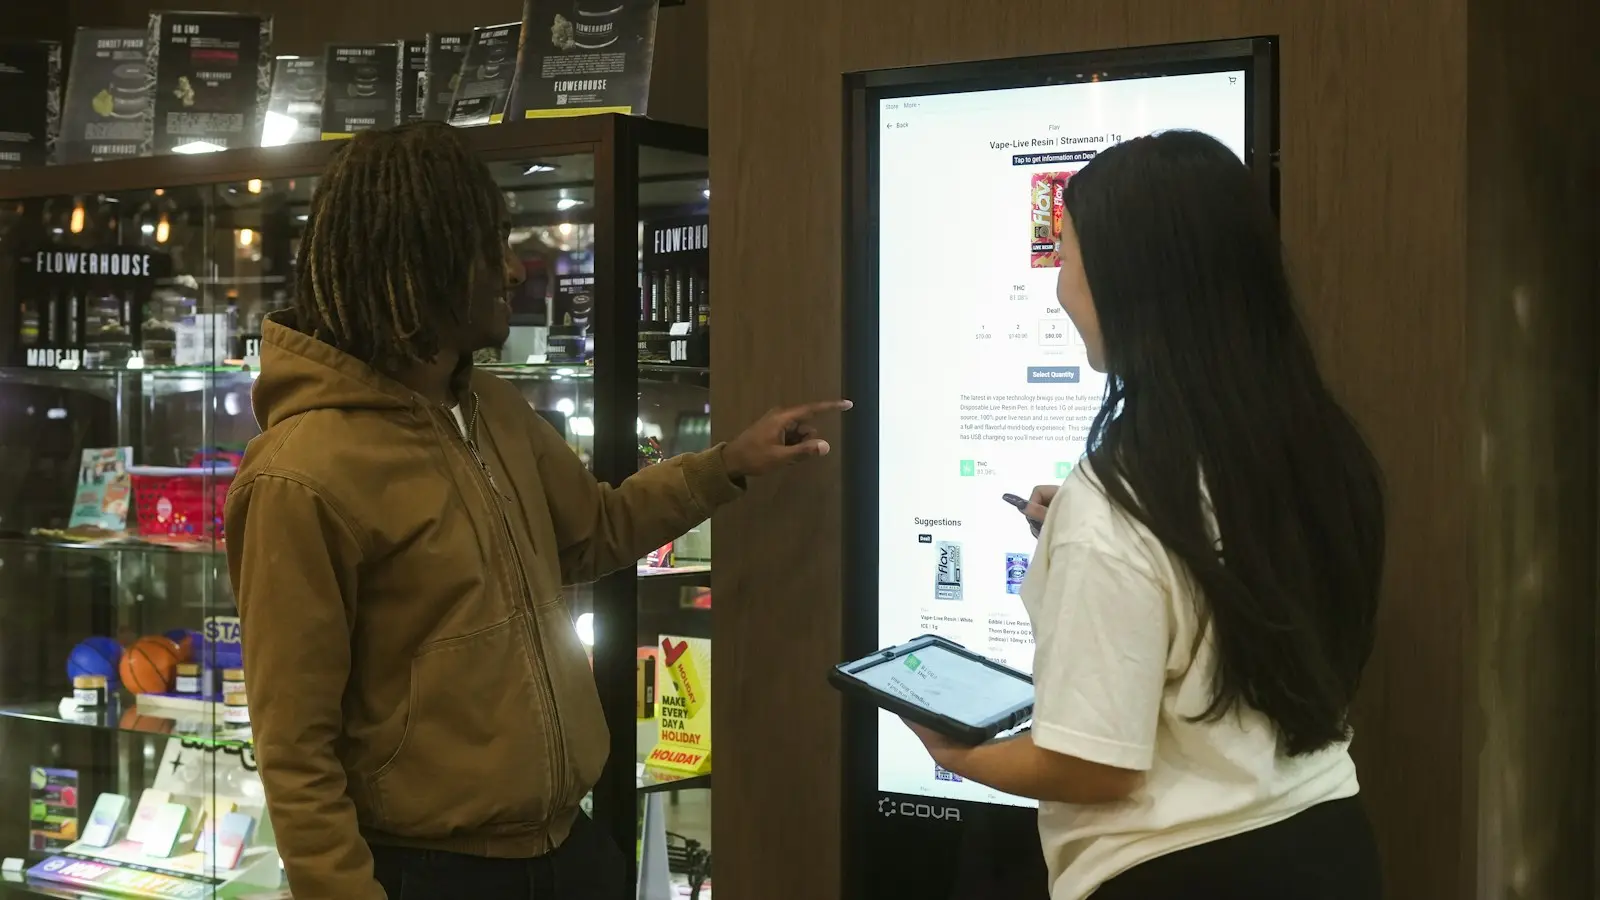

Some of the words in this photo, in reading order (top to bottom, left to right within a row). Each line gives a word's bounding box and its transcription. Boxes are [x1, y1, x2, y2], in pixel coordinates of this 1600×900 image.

[554, 79, 607, 92] FLOWERHOUSE
[990, 140, 1030, 150] Vape-Live
[1031, 138, 1054, 147] Resin
[1060, 136, 1104, 145] Strawnana
[1014, 156, 1024, 164] Tap
[1032, 156, 1041, 164] get
[1042, 154, 1074, 162] information
[654, 224, 708, 254] FLOWERHO
[36, 251, 150, 276] FLOWERHOUSE
[27, 348, 62, 367] MADE
[914, 517, 962, 527] Suggestions
[938, 547, 948, 574] flav
[678, 664, 696, 704] HOLIDAY
[662, 696, 686, 707] MAKE
[662, 706, 689, 719] EVERY
[662, 718, 678, 728] DAY
[678, 720, 684, 730] A
[662, 730, 701, 745] HOLIDAY
[651, 749, 702, 765] HOLIDAY
[900, 802, 960, 822] COVA
